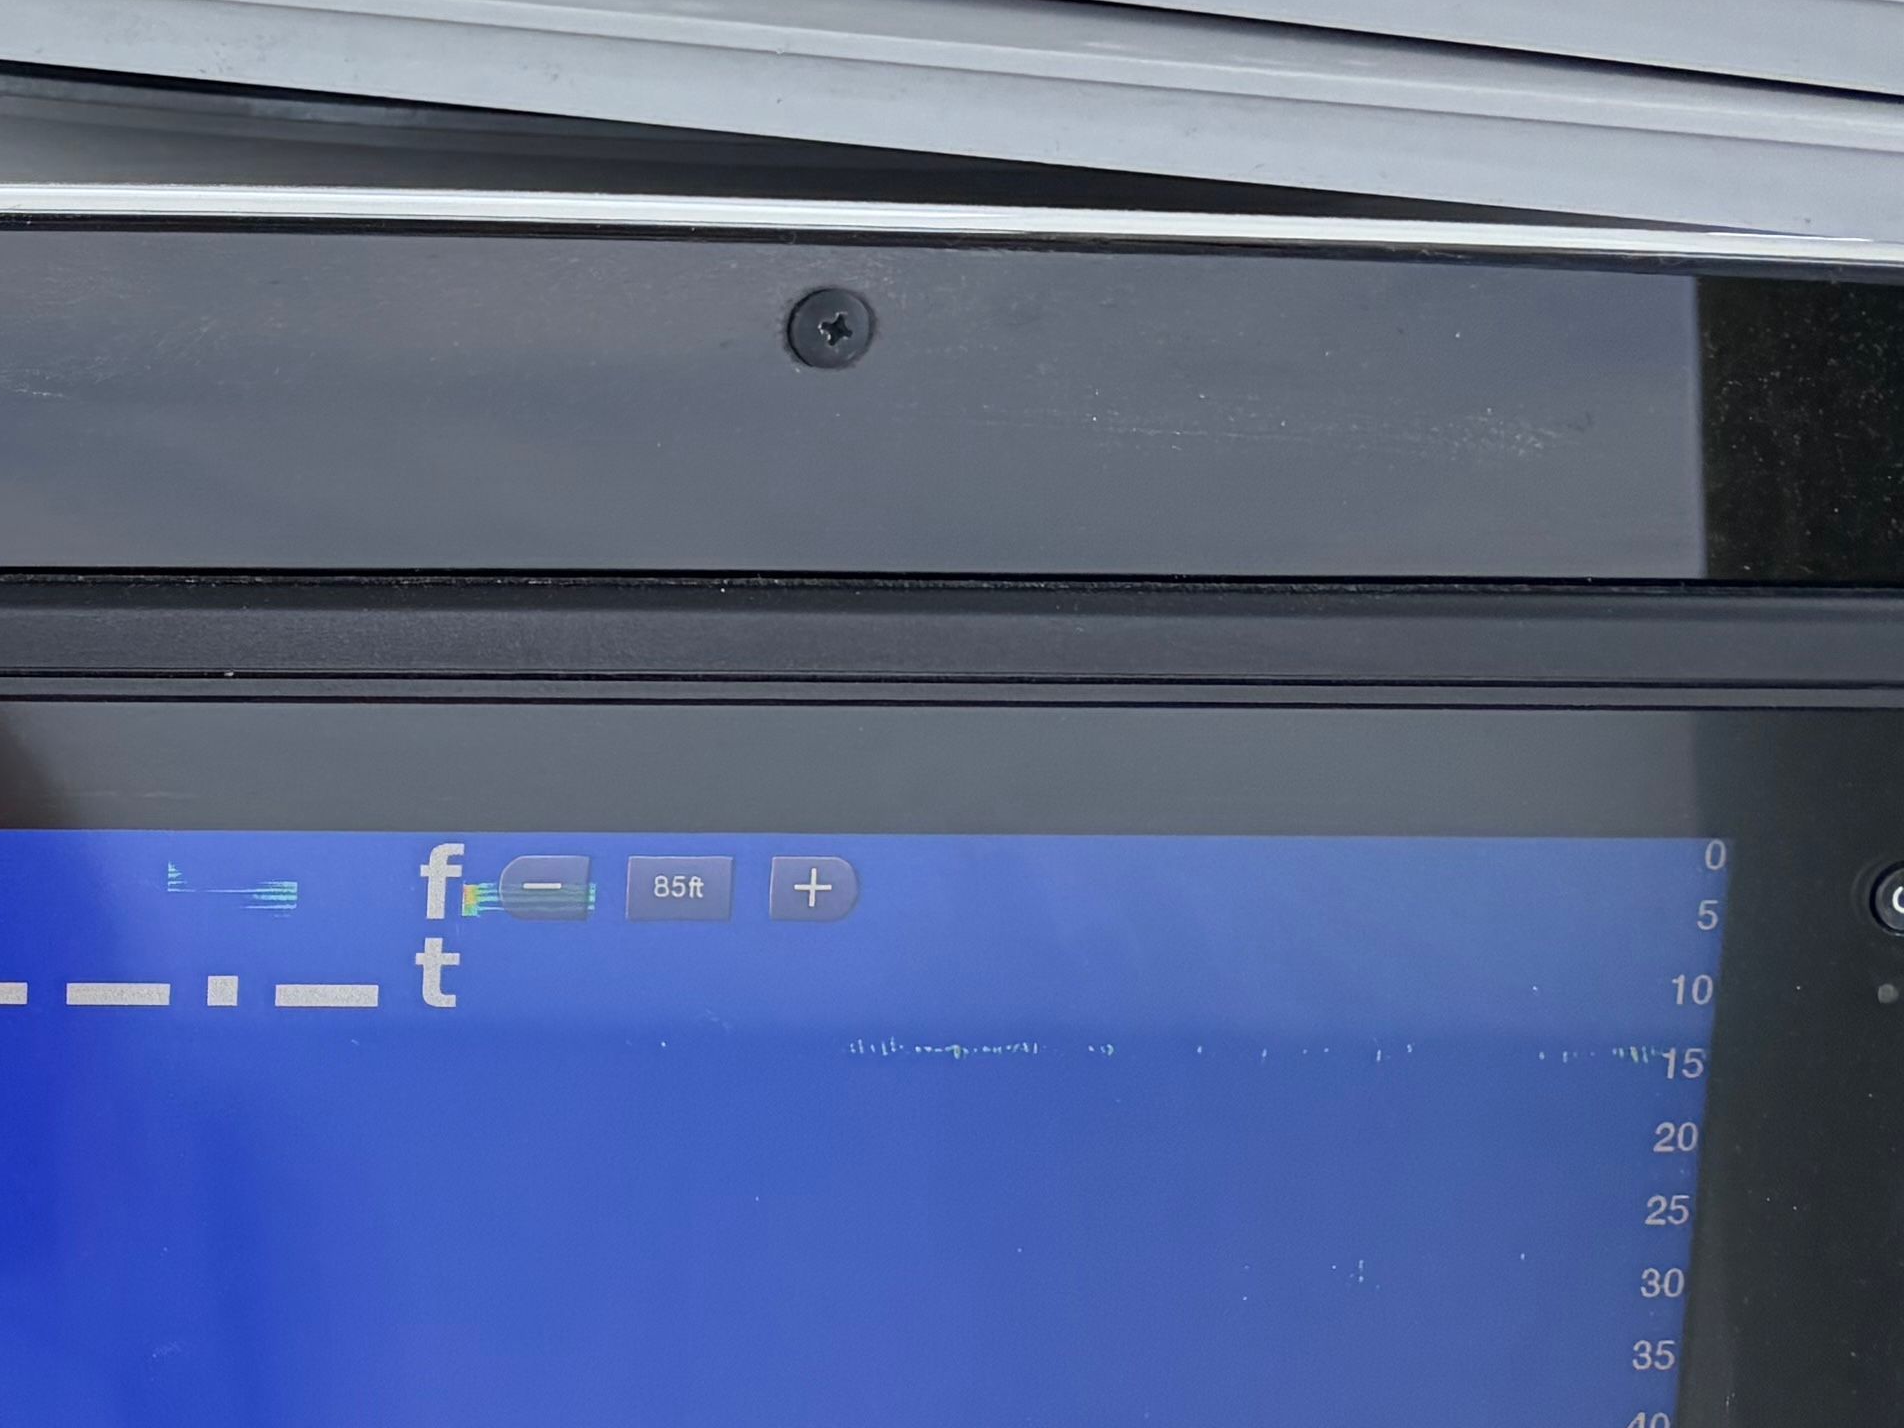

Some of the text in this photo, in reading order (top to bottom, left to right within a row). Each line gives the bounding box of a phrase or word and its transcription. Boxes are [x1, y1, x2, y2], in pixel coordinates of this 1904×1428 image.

[1705, 839, 1727, 870] 0
[652, 874, 705, 900] 85ft
[1697, 899, 1719, 931] 5
[1671, 974, 1714, 1005] 10
[1662, 1047, 1705, 1079] 15
[1653, 1121, 1699, 1153] 20
[1644, 1194, 1690, 1226] 25
[1640, 1268, 1685, 1299] 30
[1632, 1340, 1676, 1371] 35
